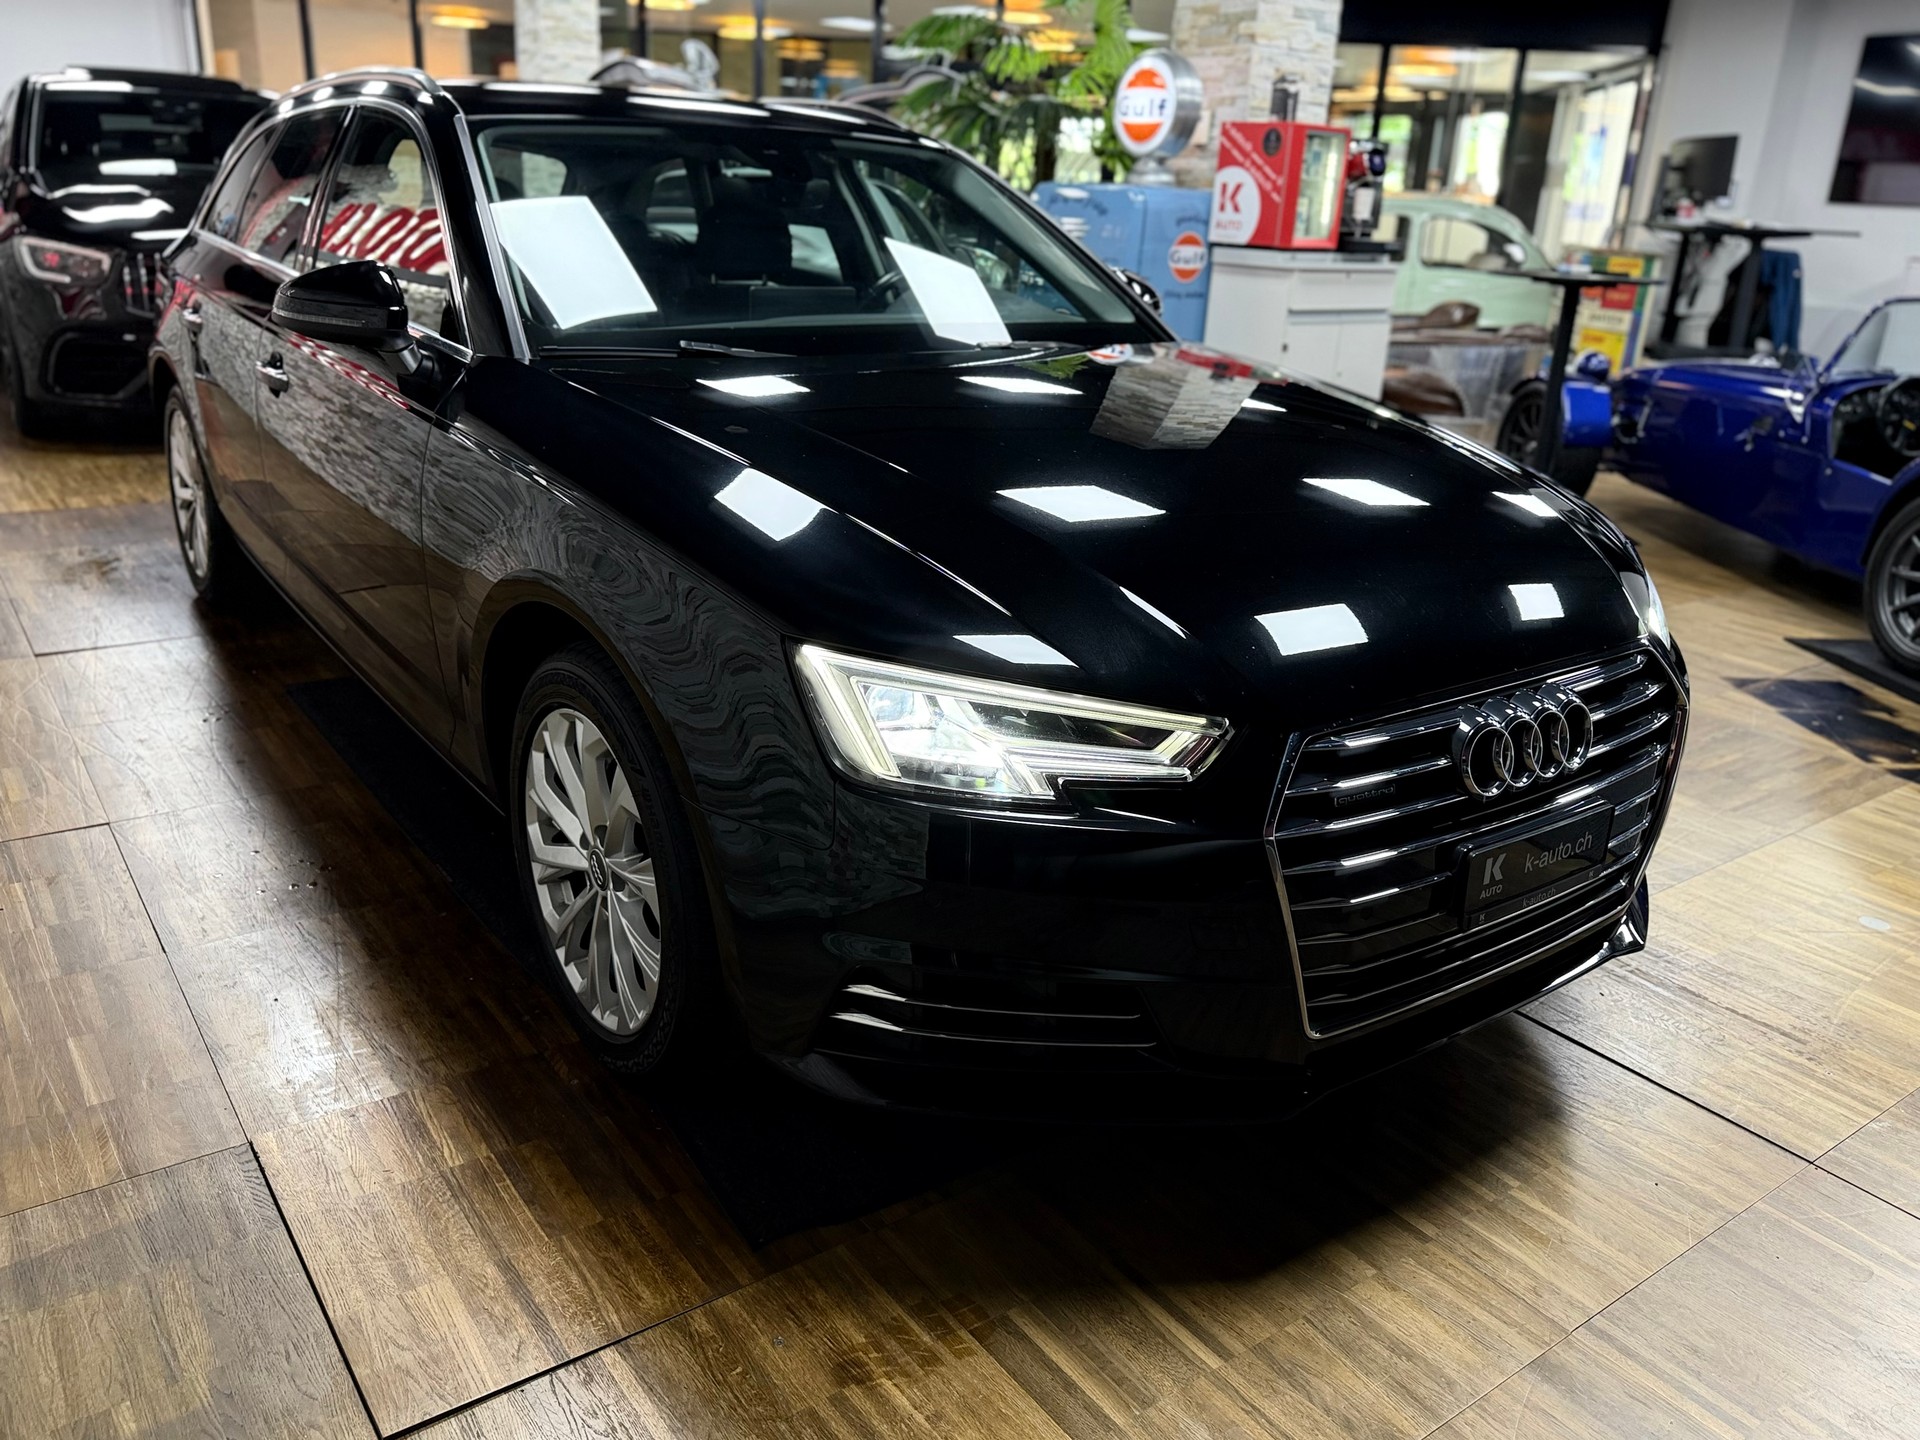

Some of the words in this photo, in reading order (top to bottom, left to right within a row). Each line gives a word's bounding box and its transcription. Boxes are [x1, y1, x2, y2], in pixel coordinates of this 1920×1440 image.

[1118, 95, 1166, 117] Gulf
[1219, 182, 1244, 213] K
[1170, 250, 1206, 264] Gulf
[1338, 786, 1394, 805] quattro
[1524, 831, 1593, 874] k-auto.ch
[1483, 852, 1507, 885] K
[1479, 884, 1503, 900] AUTO
[1522, 886, 1557, 908] k-auto.ch
